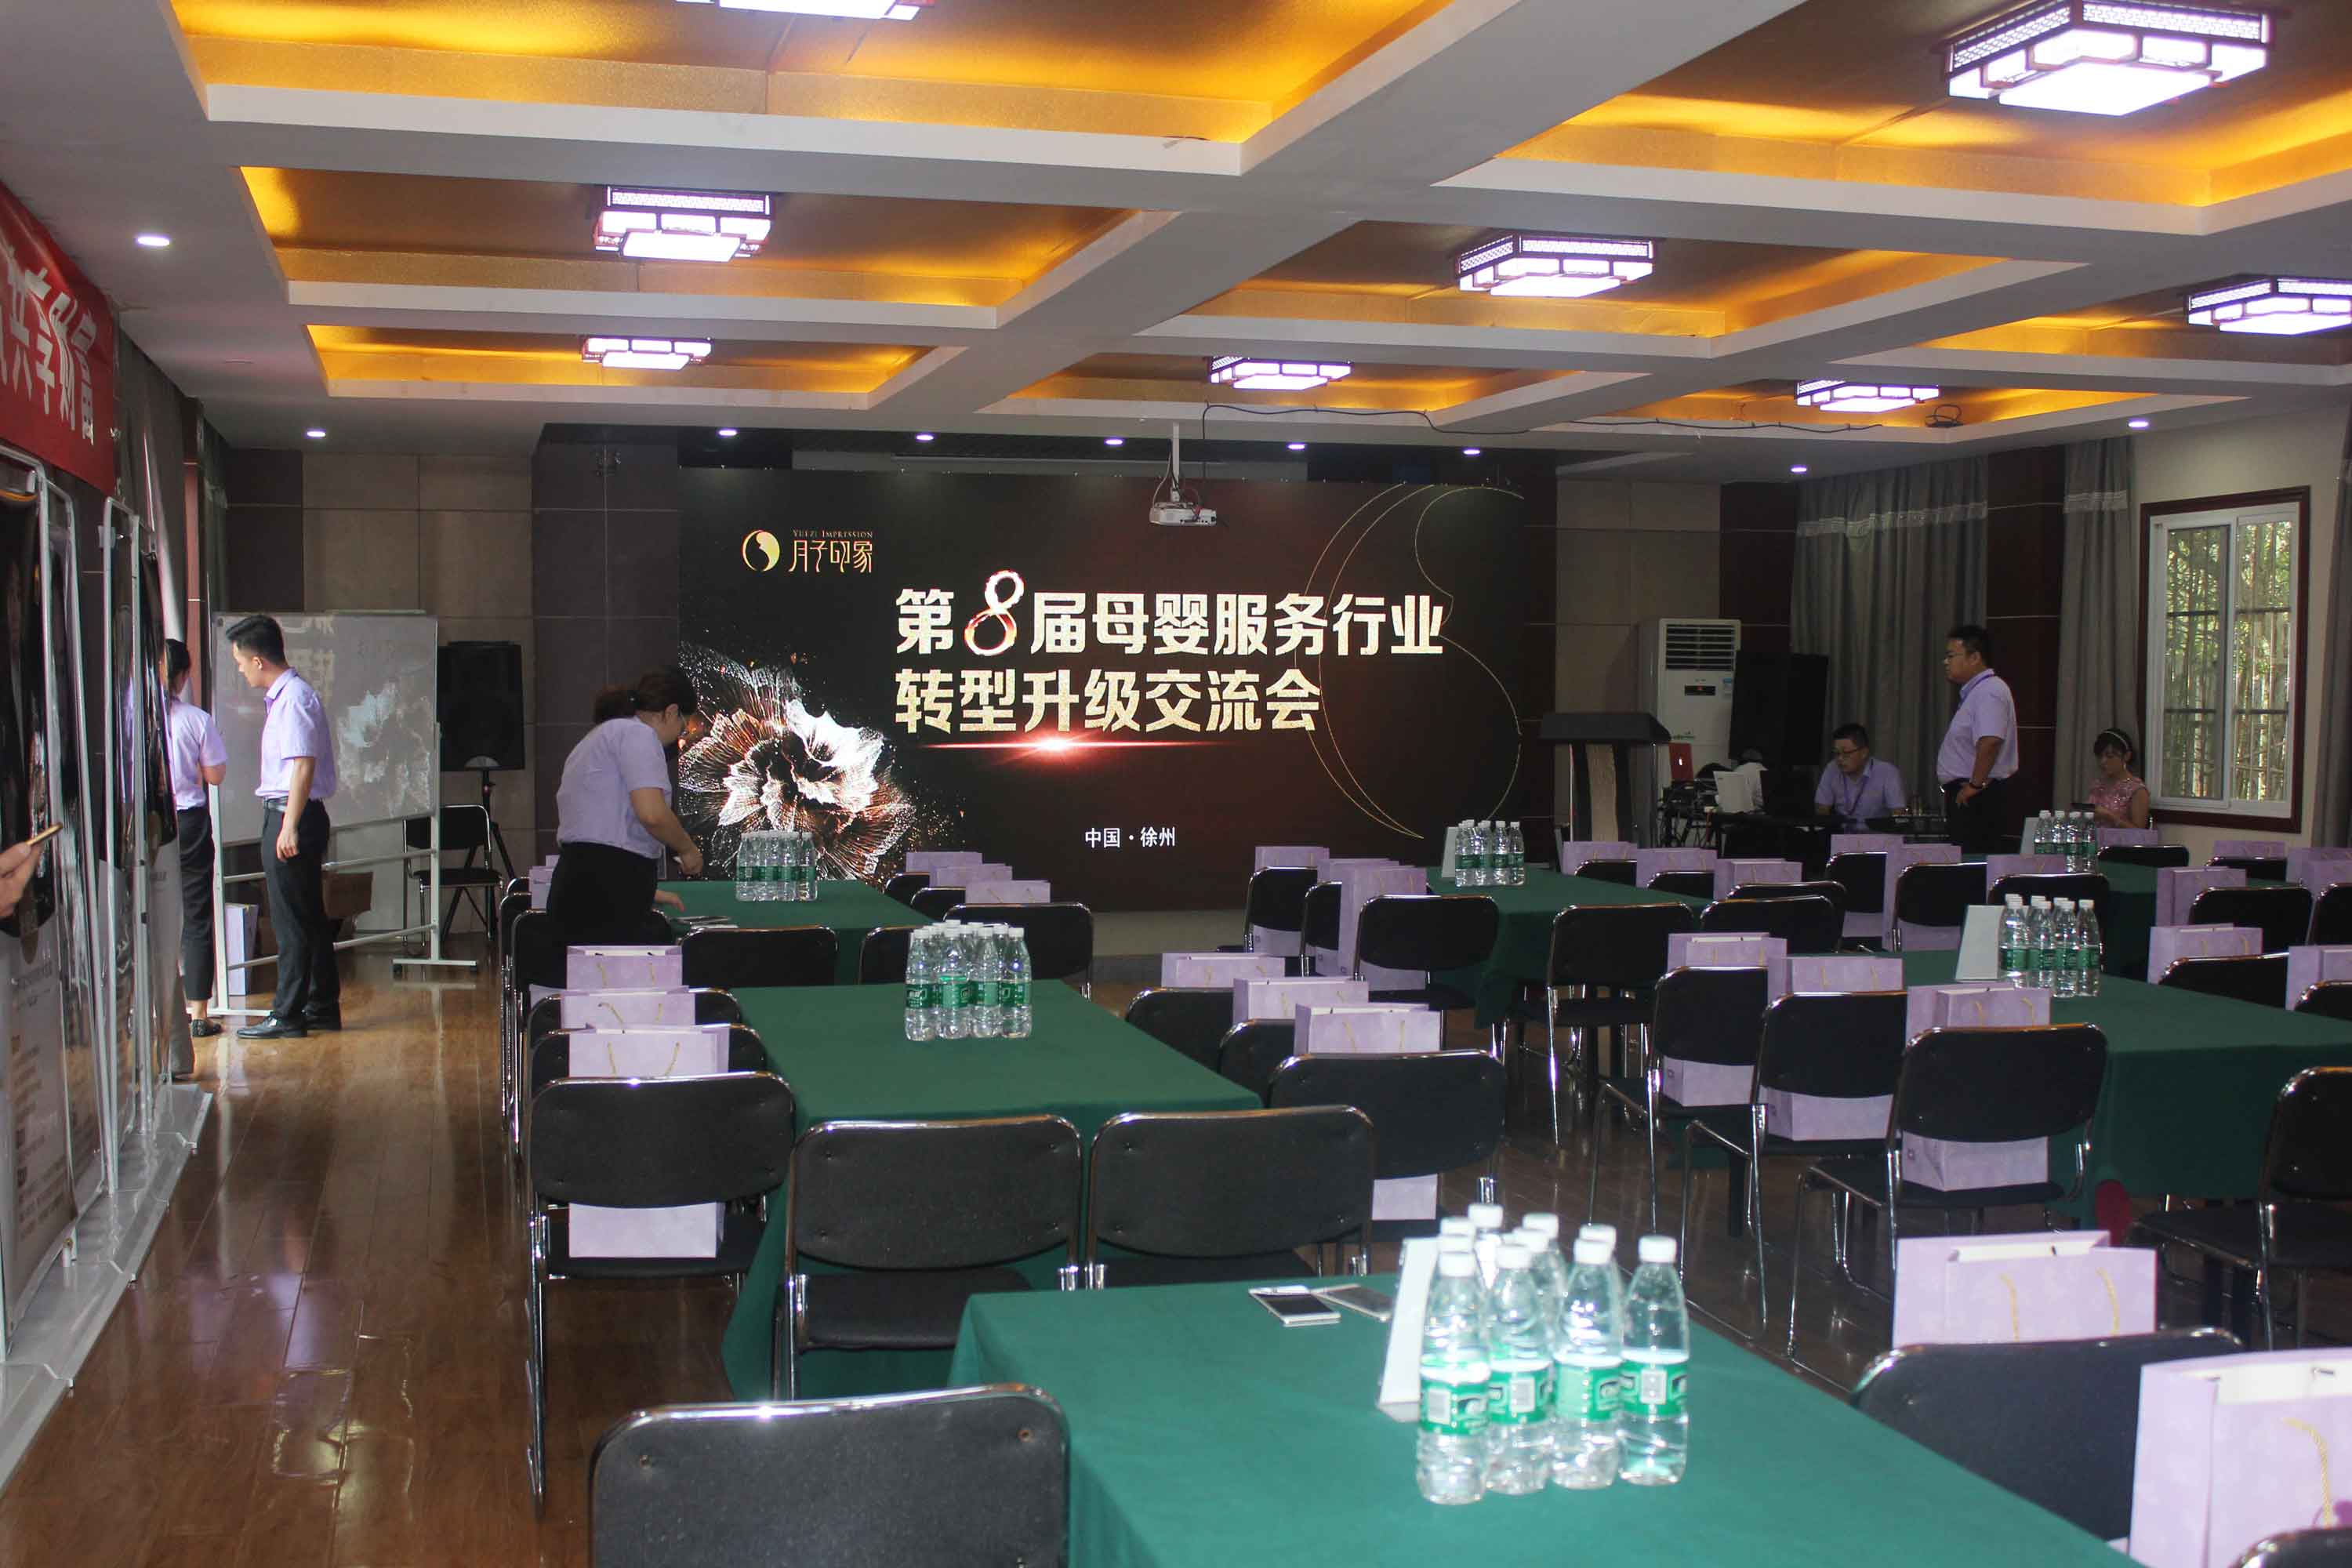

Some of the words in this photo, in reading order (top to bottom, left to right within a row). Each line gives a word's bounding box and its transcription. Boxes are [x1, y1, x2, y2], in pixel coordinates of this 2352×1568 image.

[788, 539, 873, 573] 月子印象
[896, 570, 1443, 657] 第8届母婴服务行业
[895, 669, 1321, 734] 转型升级交流会
